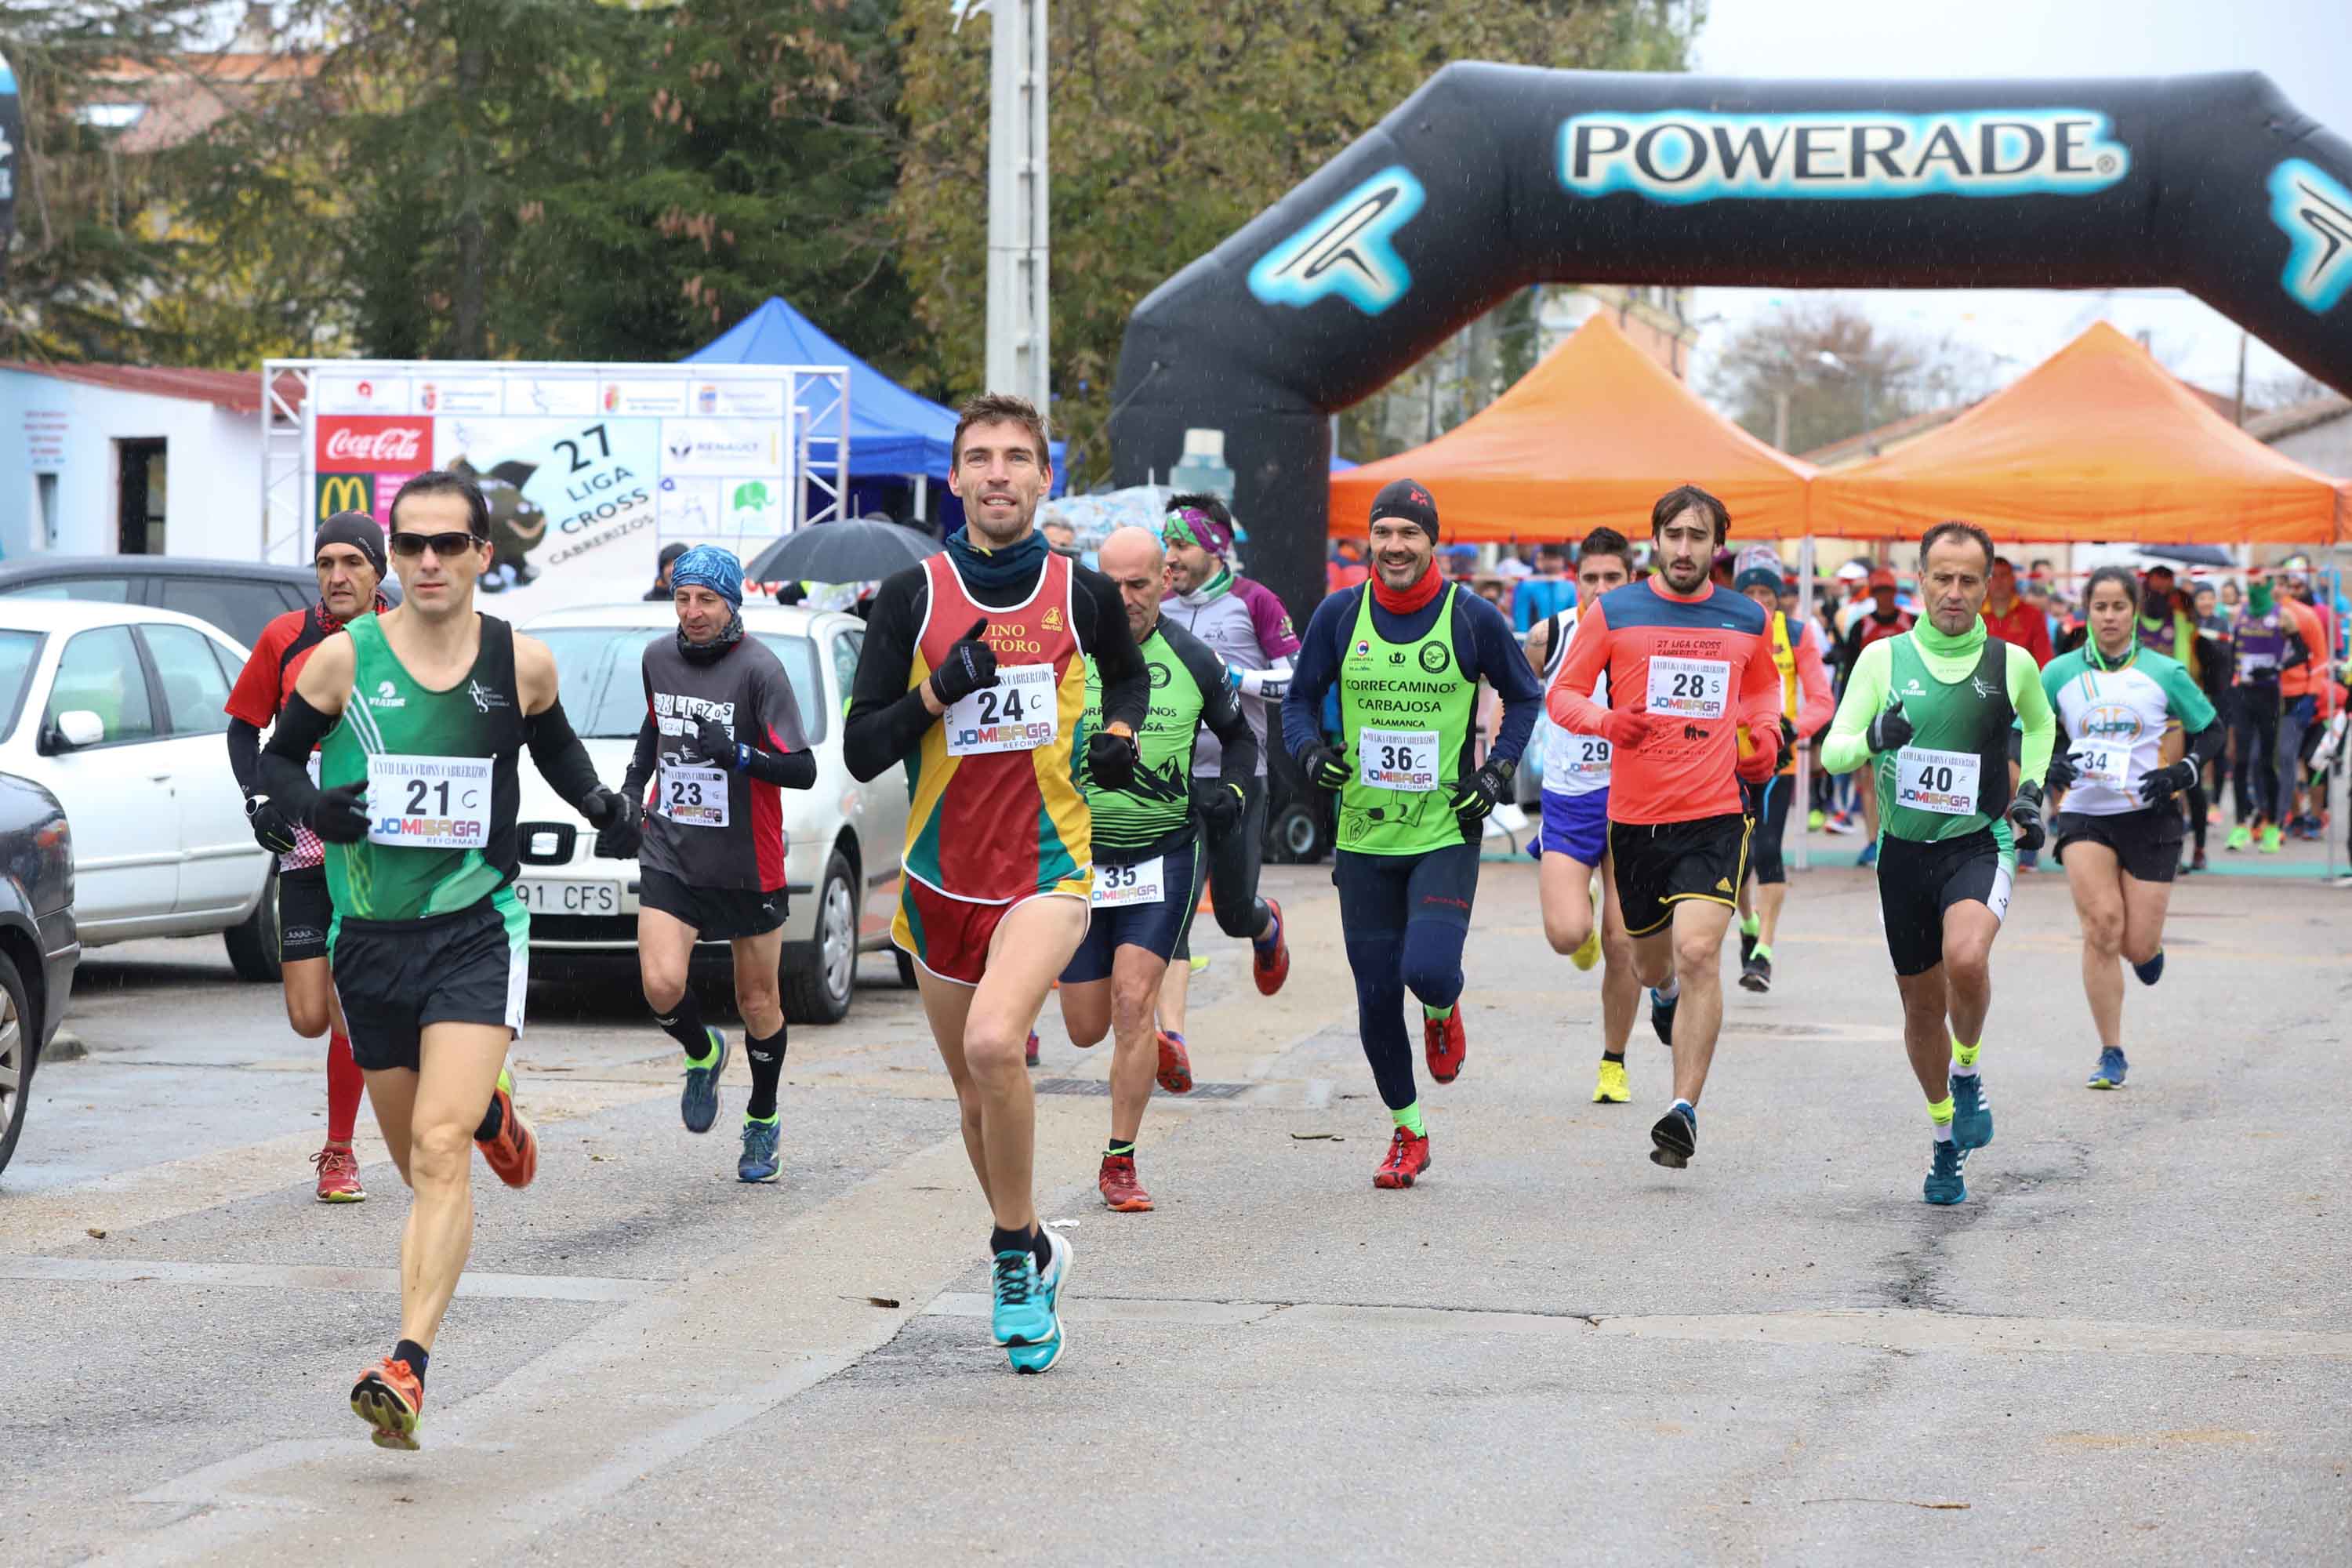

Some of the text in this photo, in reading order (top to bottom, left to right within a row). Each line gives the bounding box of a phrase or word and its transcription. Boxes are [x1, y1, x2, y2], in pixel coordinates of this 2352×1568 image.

[1573, 121, 2094, 183] POWERADE
[552, 422, 611, 473] 27
[566, 466, 635, 502] LIGA
[560, 487, 649, 535] CROSS
[549, 514, 655, 566] CABRERIZOS
[989, 639, 1042, 654] TORO
[1346, 679, 1458, 694] CORRECAMINOS
[1672, 673, 1704, 698] 28
[978, 688, 1024, 725] 24
[1358, 698, 1442, 713] CARBAJOSA
[954, 722, 1051, 746] JOMISAGA
[1370, 718, 1425, 728] SALAMANCA
[1381, 746, 1412, 771] 36
[1582, 742, 1609, 761] 29
[2085, 750, 2107, 771] 34
[1918, 765, 1952, 793] 40
[405, 779, 449, 816] 21
[671, 781, 702, 806] 23
[374, 817, 481, 837] JOMISAGA
[426, 837, 479, 846] REFORMAS
[1105, 865, 1137, 888] 35
[564, 885, 613, 911] CFS
[1091, 884, 1157, 901] OMISAGA
